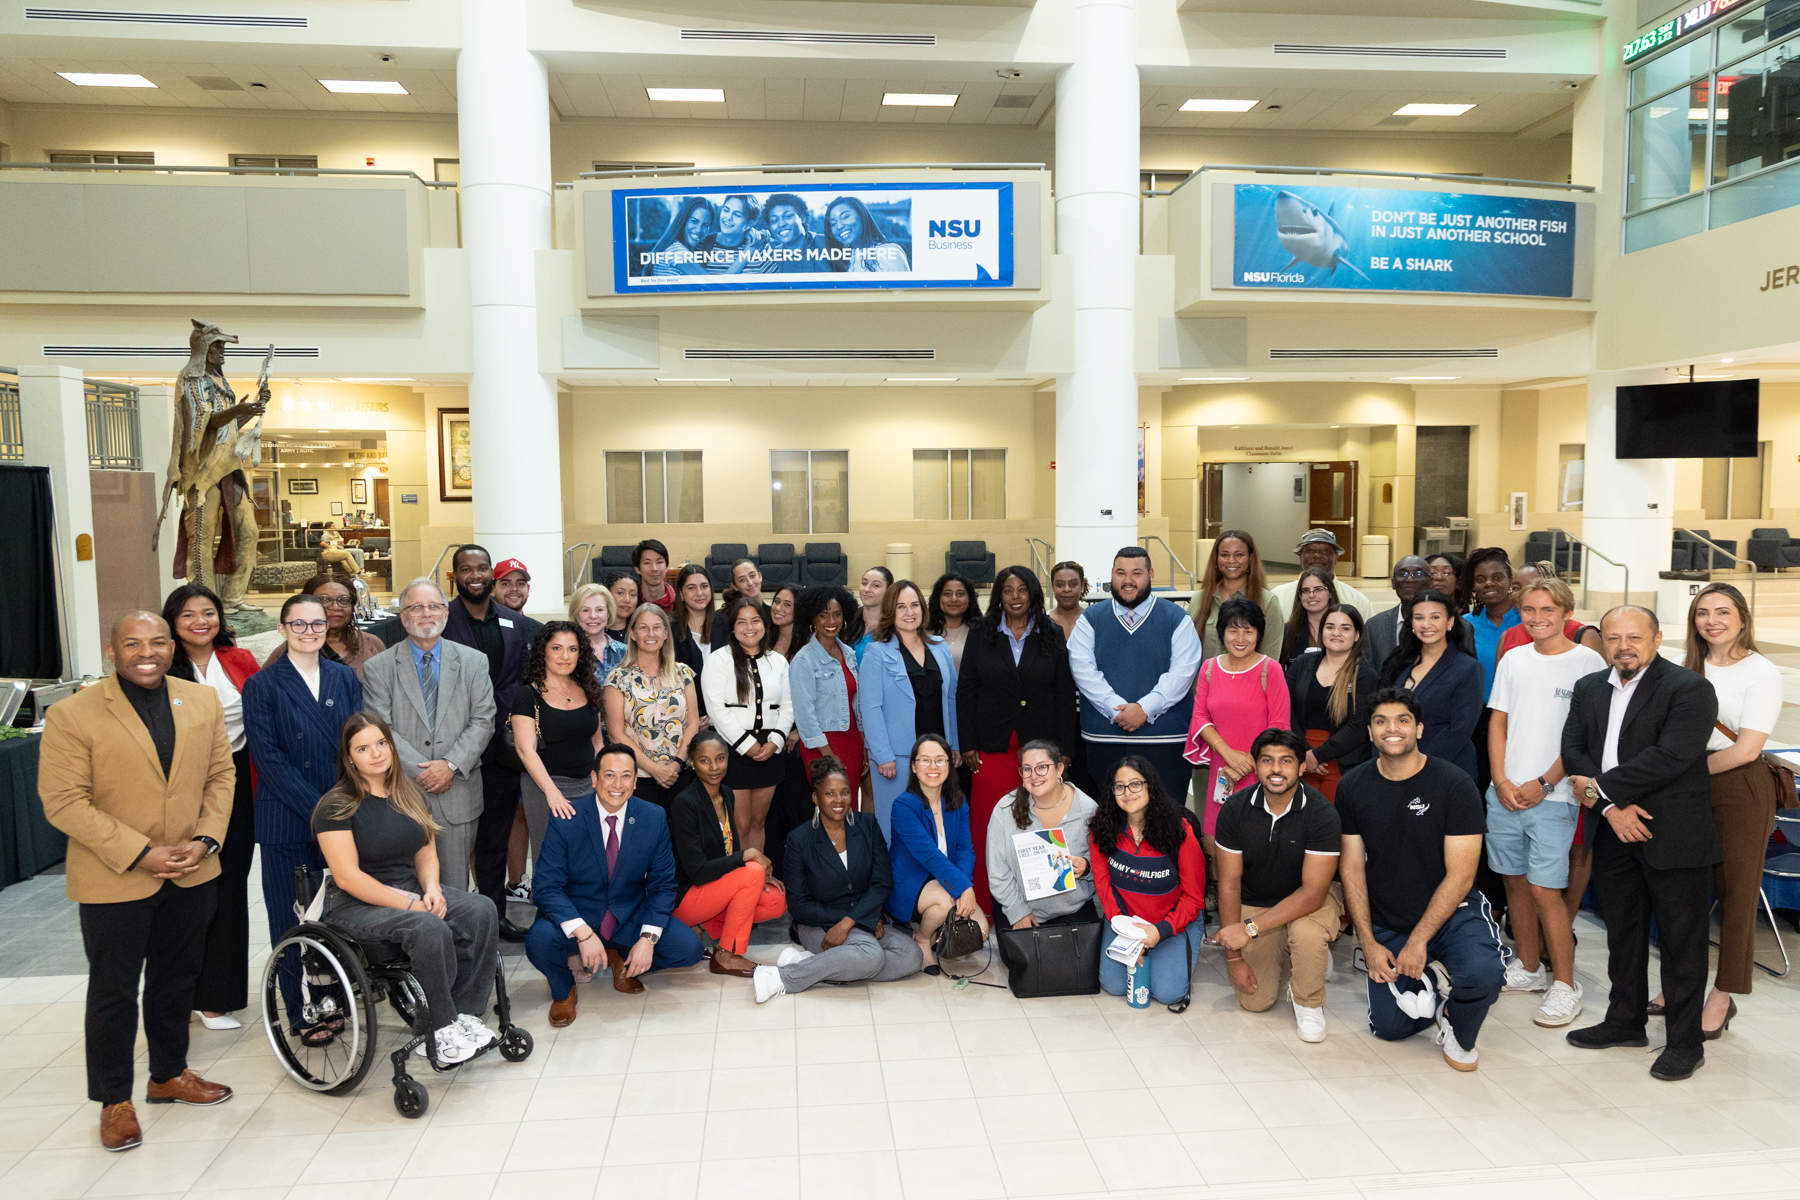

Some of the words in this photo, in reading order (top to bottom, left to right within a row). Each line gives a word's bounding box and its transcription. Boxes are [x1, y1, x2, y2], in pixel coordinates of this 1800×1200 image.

[1623, 30, 1657, 61] 217.63
[928, 220, 980, 238] NSU
[1371, 210, 1416, 224] DON'T
[1419, 212, 1437, 225] BE
[1439, 213, 1473, 227] JUST
[1475, 215, 1537, 231] ANOTHER
[1540, 220, 1567, 233] FISH
[1371, 225, 1386, 237] IN
[1389, 225, 1423, 239] JUST
[1426, 228, 1491, 243] ANOTHER
[1493, 232, 1546, 246] SCHOOL
[928, 240, 972, 250] Business
[640, 250, 735, 265] DIFFERENCE
[738, 248, 803, 262] MAKERS
[806, 247, 852, 261] MADE
[856, 246, 897, 260] HERE
[1370, 257, 1389, 269] BE
[1392, 257, 1403, 270] A
[1406, 258, 1453, 271] SHARK
[354, 402, 389, 412] AFFAIRS
[1139, 868, 1170, 879] HILFIGER
